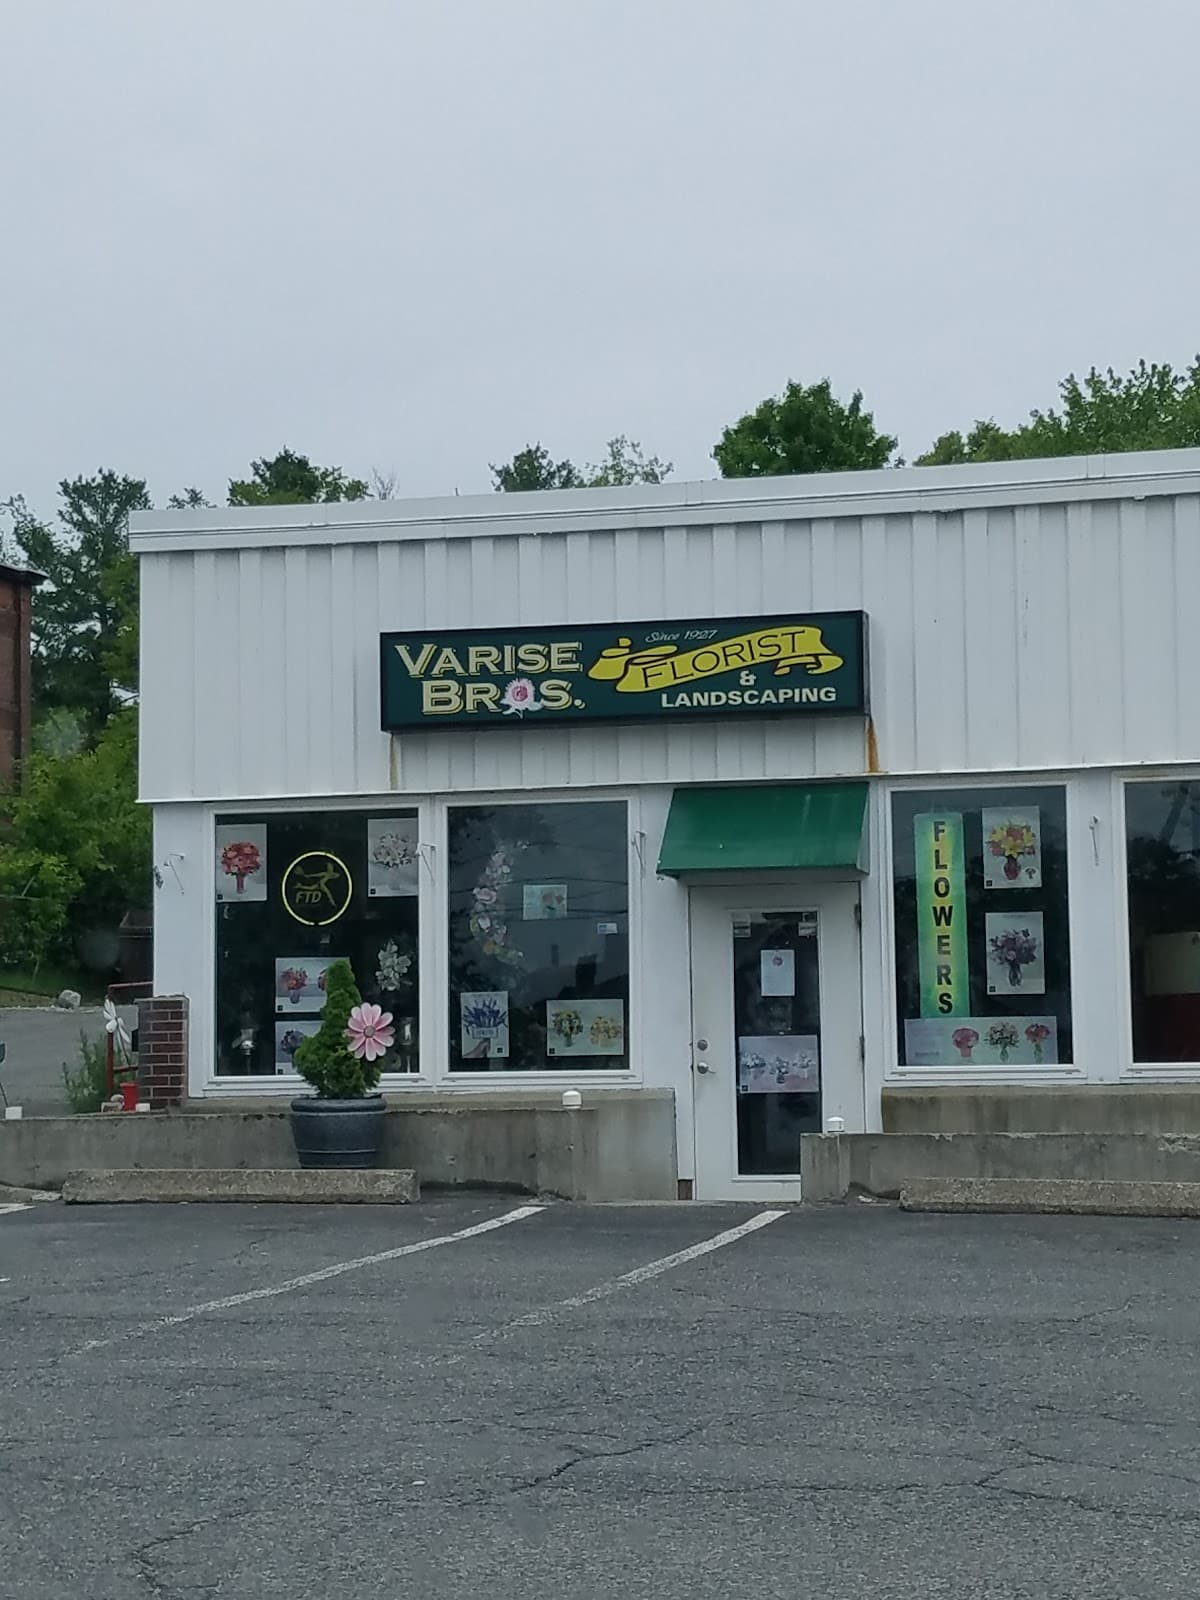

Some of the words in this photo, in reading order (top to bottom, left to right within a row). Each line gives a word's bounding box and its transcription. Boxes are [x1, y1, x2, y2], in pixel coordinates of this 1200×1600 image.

[645, 631, 680, 643] Since
[684, 629, 718, 640] 1927
[394, 641, 583, 678] VARISE
[642, 629, 806, 689] FLORIST
[739, 670, 756, 686] &
[661, 687, 837, 708] LANDSCAPING
[296, 891, 322, 904] FTD
[932, 820, 954, 1015] FLOWERS
